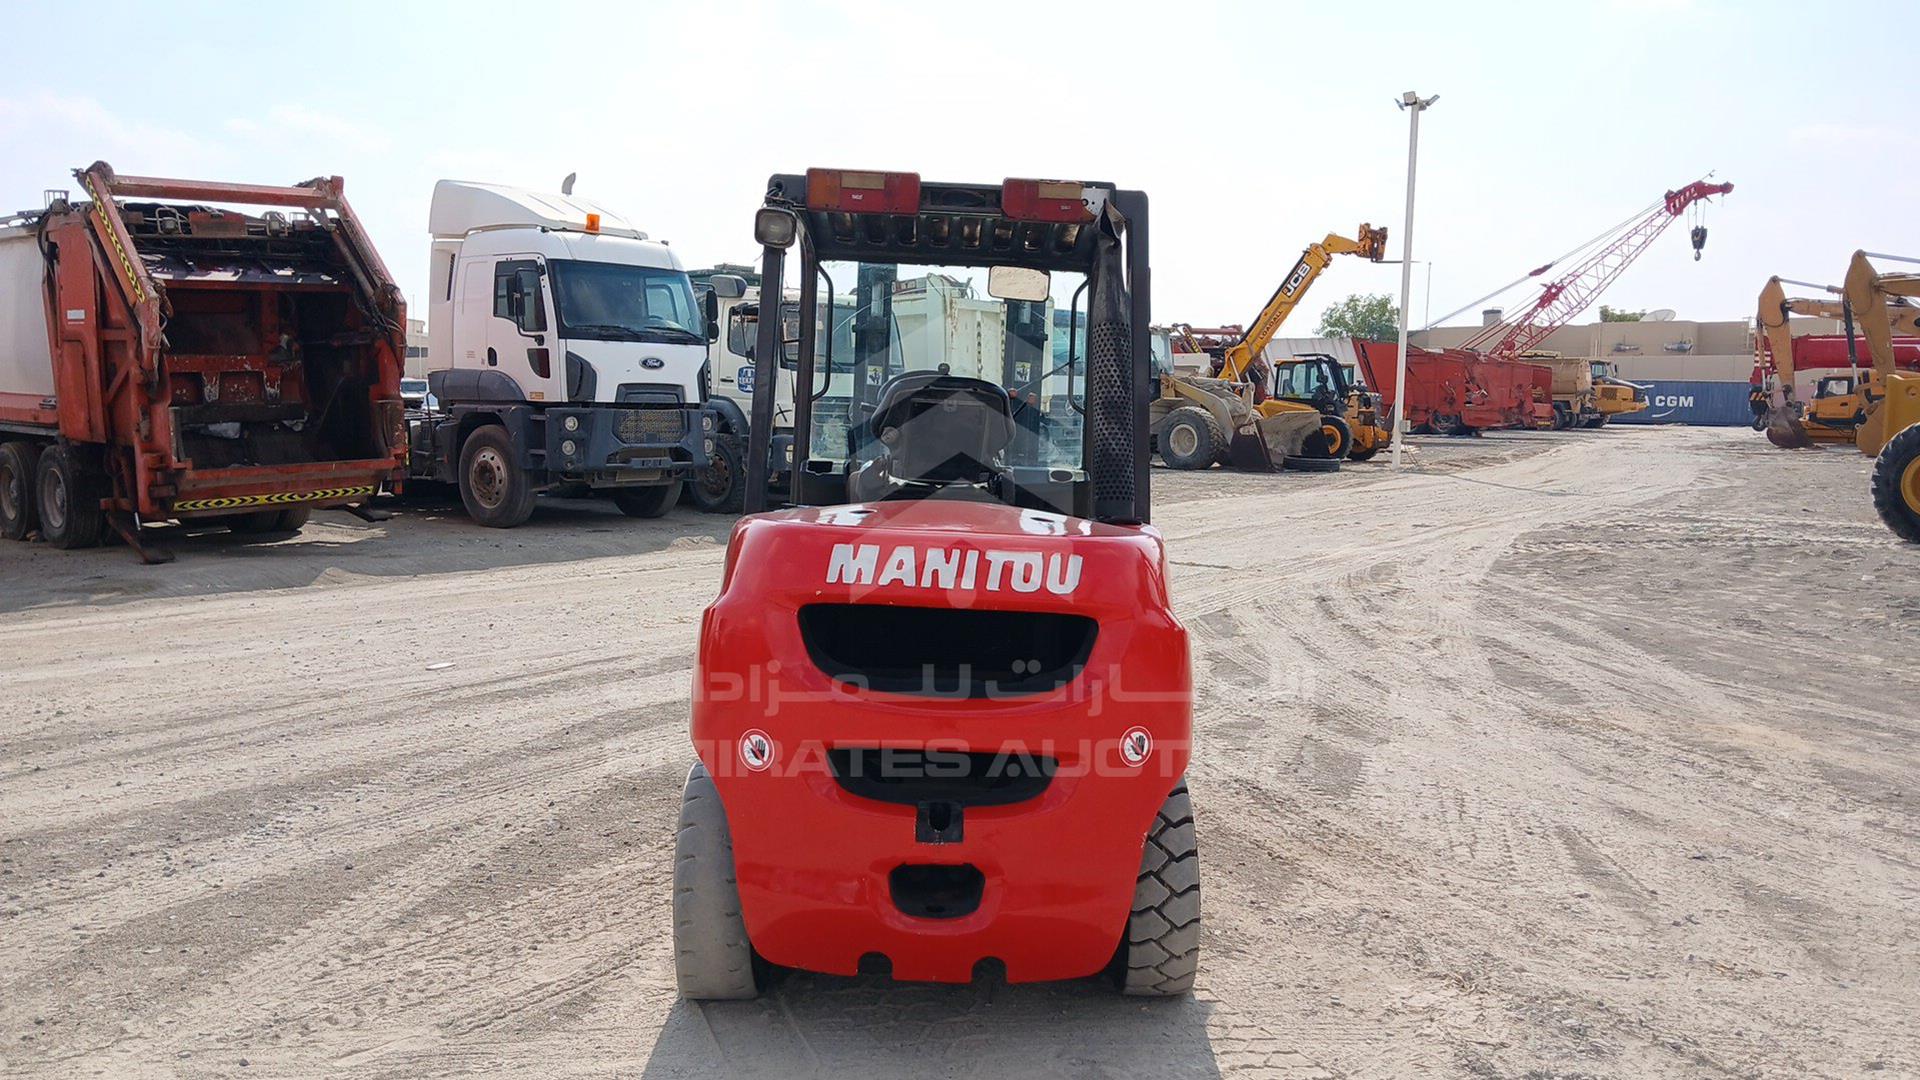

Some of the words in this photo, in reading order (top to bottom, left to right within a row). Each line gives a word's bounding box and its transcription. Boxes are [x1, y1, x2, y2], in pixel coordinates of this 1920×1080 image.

[1286, 262, 1311, 297] JCB
[1260, 310, 1283, 340] LOADALL
[1655, 395, 1694, 407] CGM
[826, 543, 1083, 595] MANITOU
